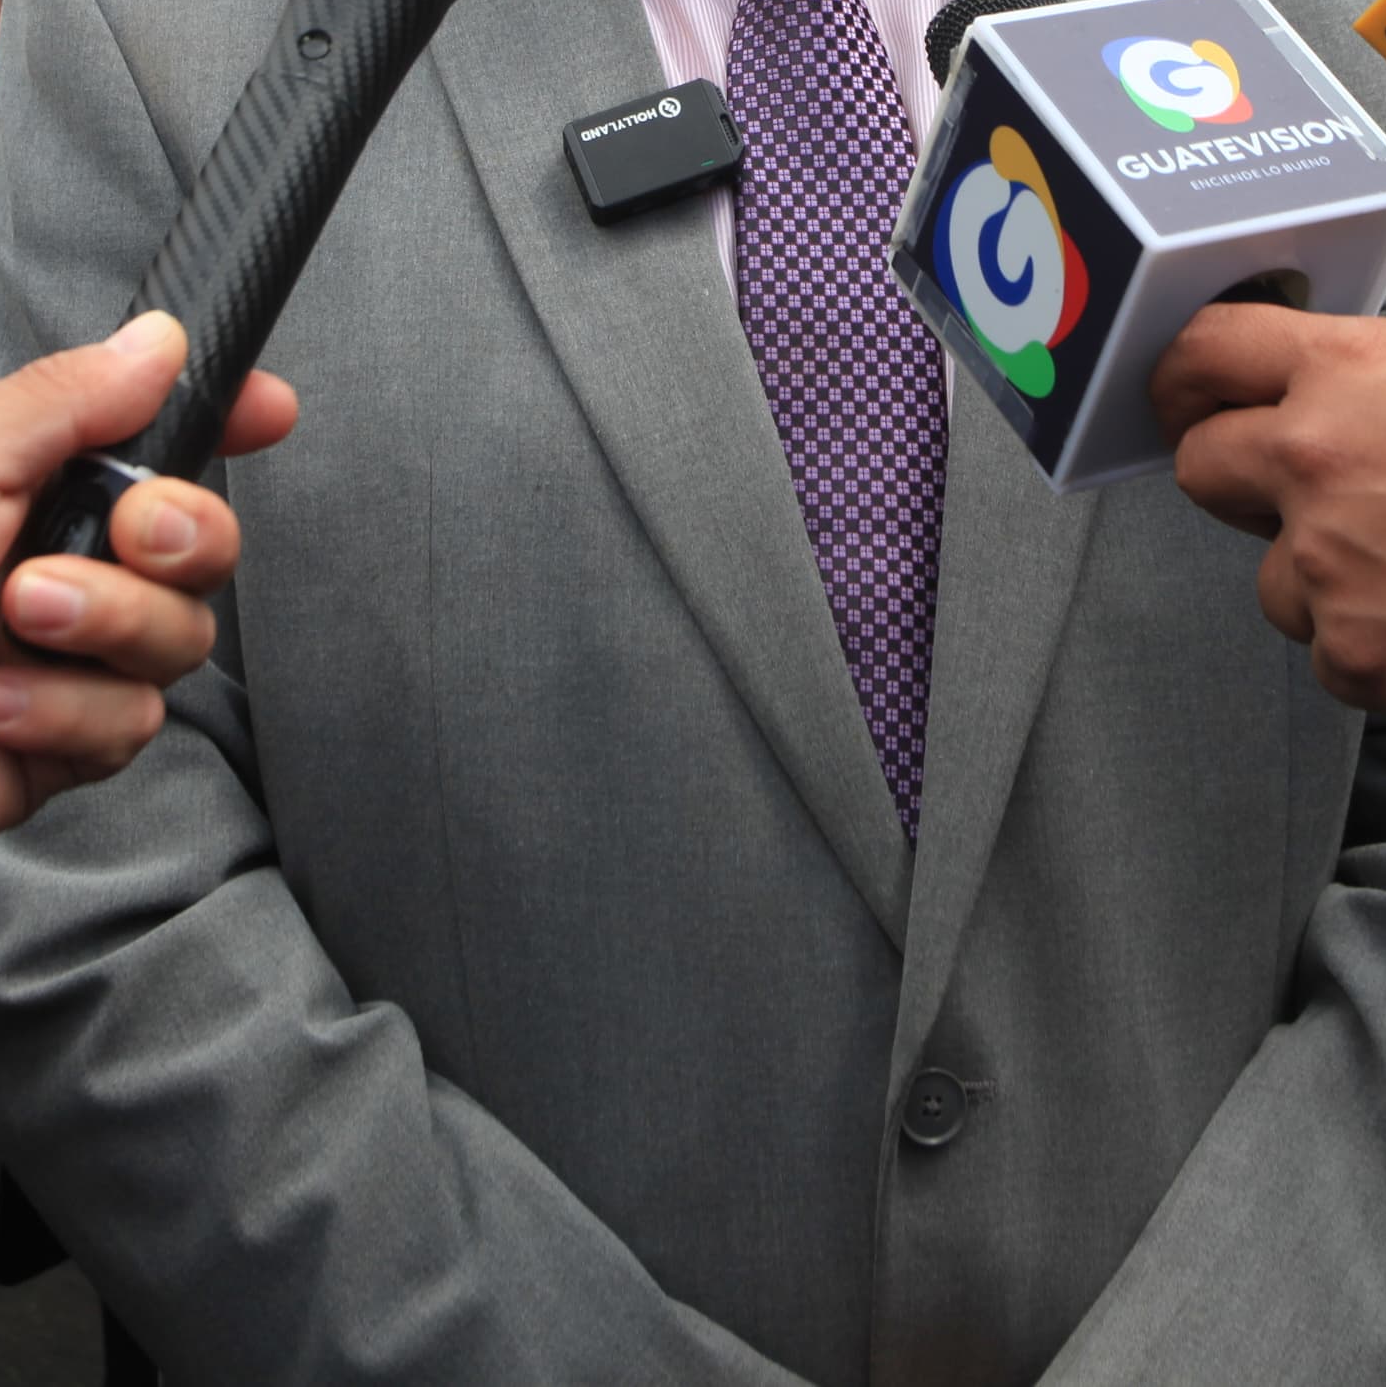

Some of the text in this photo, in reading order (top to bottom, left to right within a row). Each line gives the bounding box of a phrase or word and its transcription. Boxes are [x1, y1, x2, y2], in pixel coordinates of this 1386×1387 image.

[580, 107, 658, 142] HOLLYLAND
[1116, 116, 1364, 180] GUATEVISION
[1190, 155, 1331, 191] ENCIENDE LO BUENO
